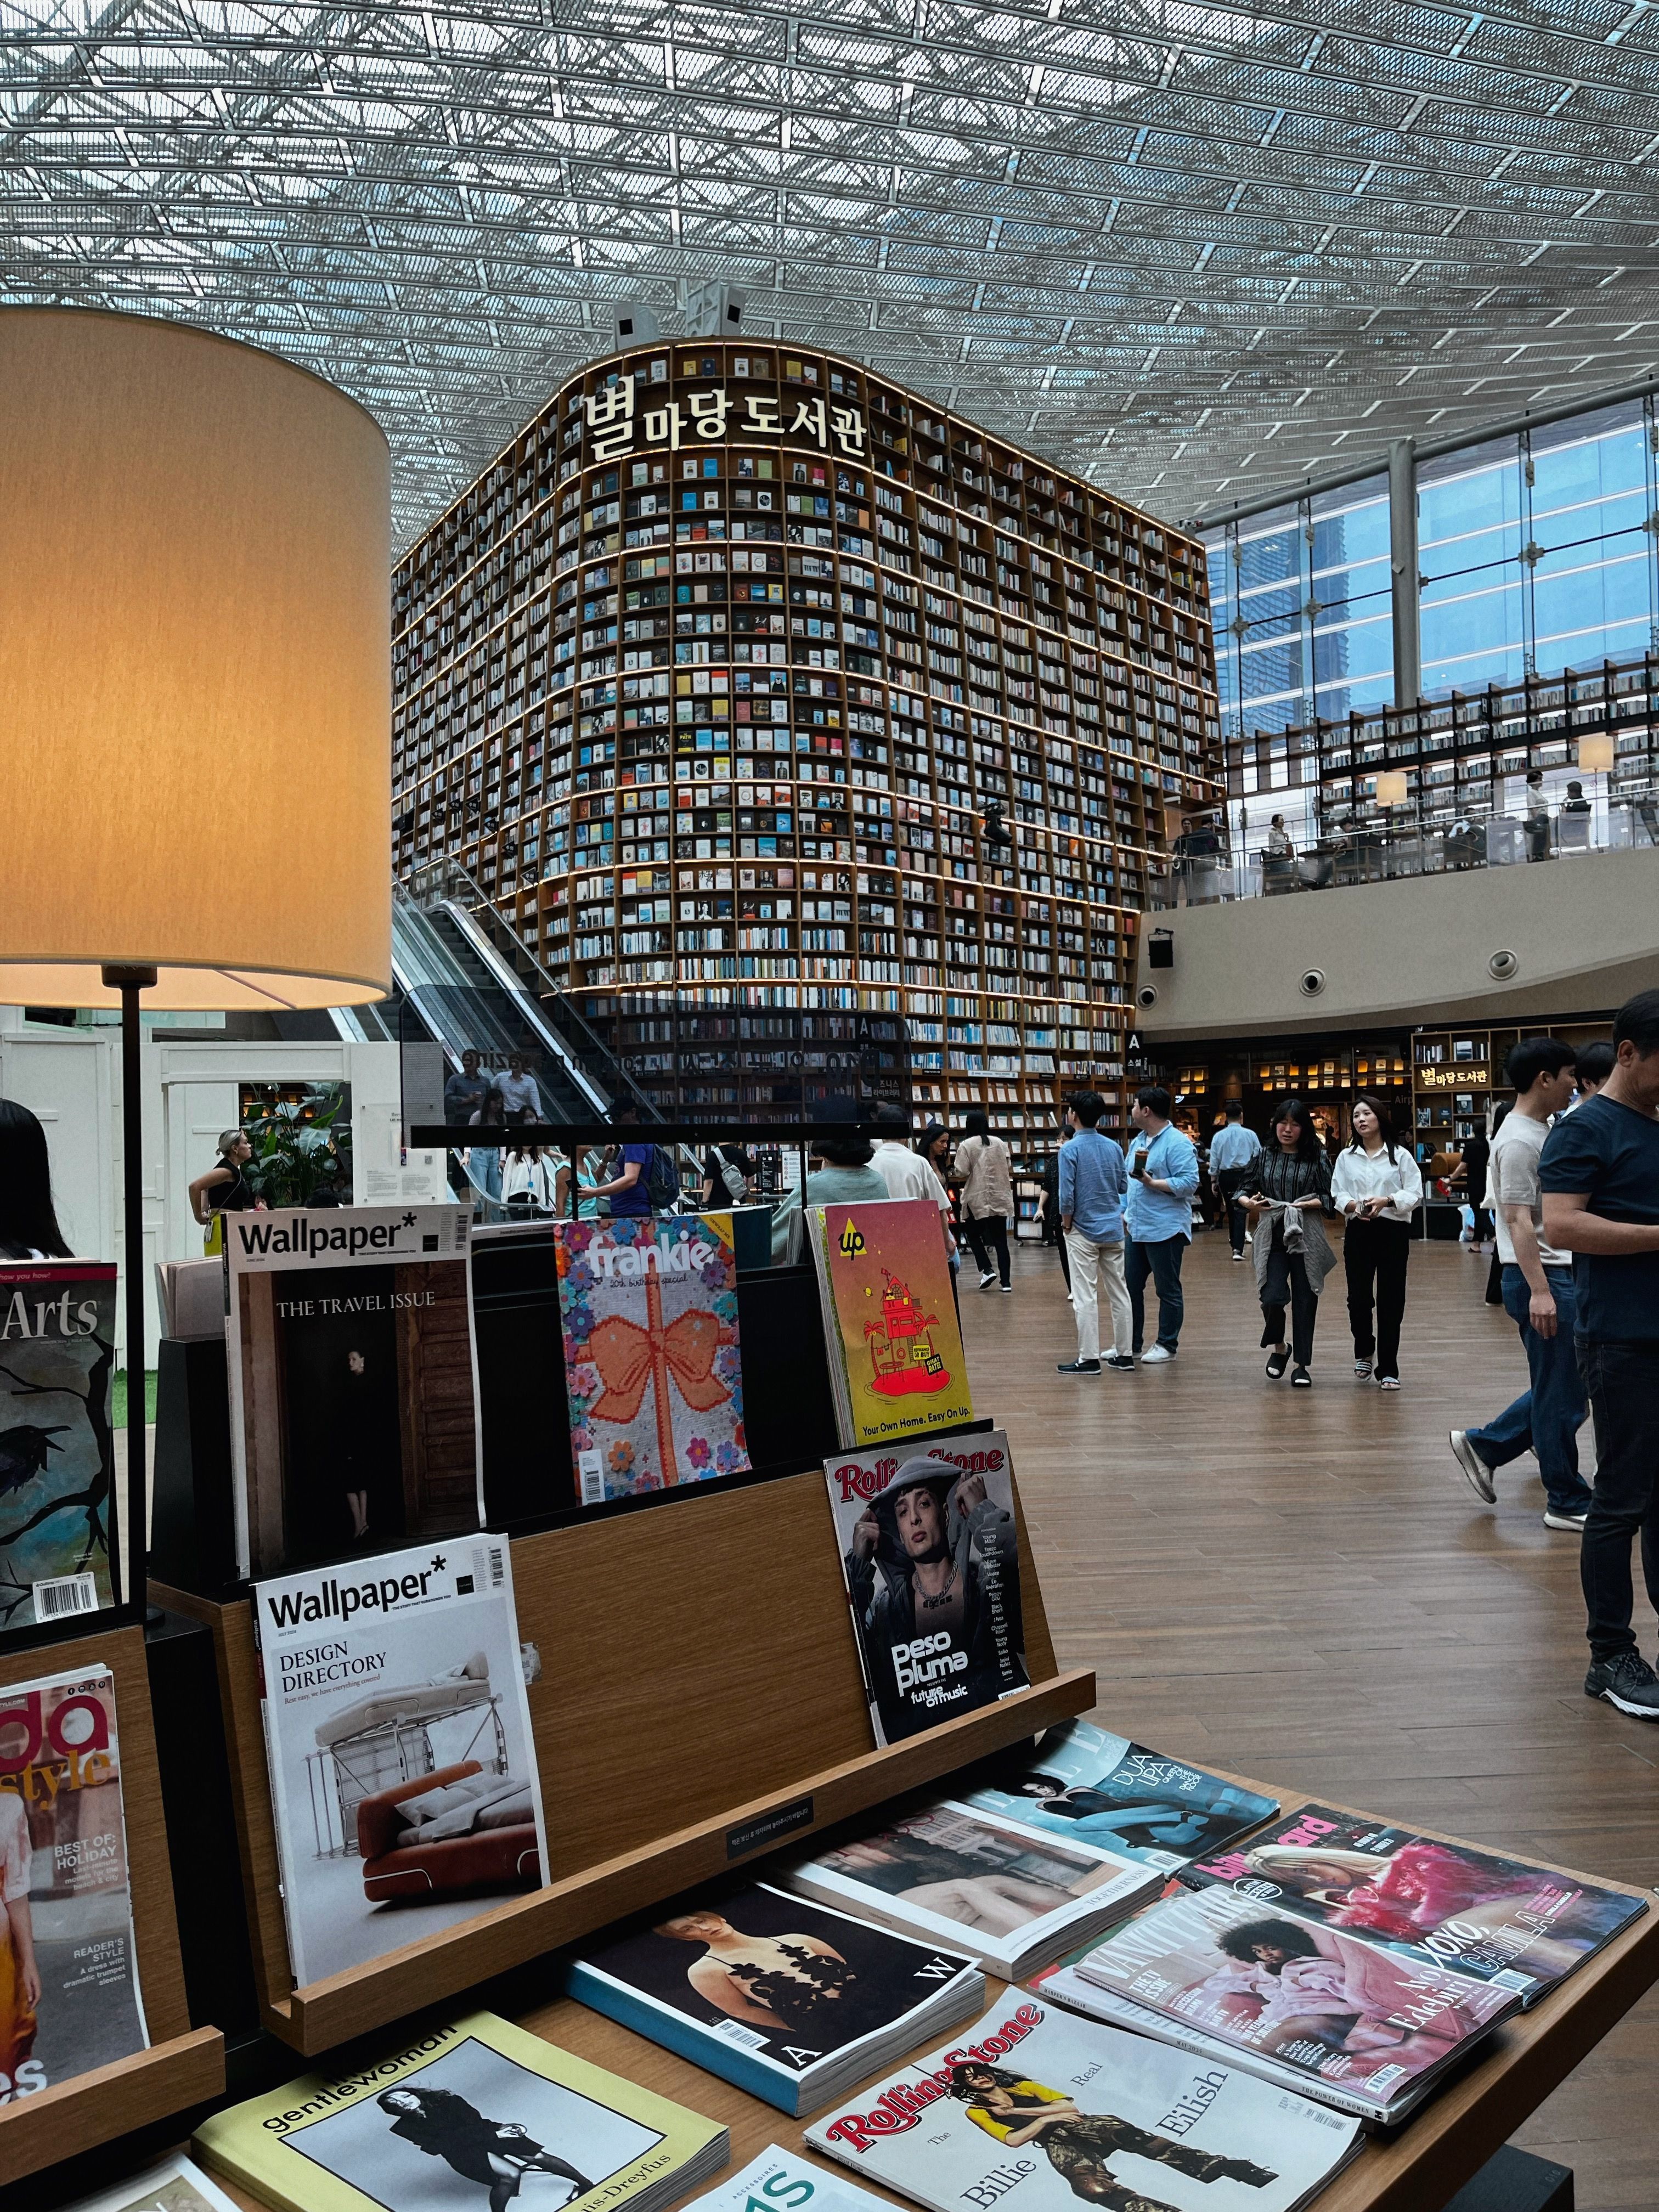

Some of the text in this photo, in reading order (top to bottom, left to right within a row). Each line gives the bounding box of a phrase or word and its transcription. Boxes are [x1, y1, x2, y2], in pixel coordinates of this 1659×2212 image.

[860, 1018, 868, 1035] A
[1128, 1034, 1140, 1049] A
[585, 1230, 714, 1278] frankie
[838, 1232, 865, 1261] up
[0, 1290, 98, 1340] Arts
[276, 1291, 436, 1318] THE TRAVEL ISSUE
[862, 1407, 970, 1436] Your Own Home. Easy On Up.
[834, 1457, 904, 1503] Rolli
[280, 1640, 348, 1672] DESIGN
[282, 1652, 387, 1693] DIRECTORY
[284, 1696, 297, 1705] Rest
[332, 1680, 361, 1692] everything
[360, 1674, 380, 1684] covered
[911, 1685, 944, 1704] future
[938, 1684, 968, 1702] music
[0, 1749, 111, 1810] style
[1112, 1756, 1153, 1786] DUA
[1137, 1763, 1172, 1787] LIPA
[1162, 1764, 1178, 1784] QUEEN
[1178, 1773, 1197, 1790] DANCE
[1179, 1770, 1191, 1780] THE
[55, 1833, 116, 1858] BEST OF:
[57, 1844, 116, 1870] HOLIDAY
[1194, 1814, 1339, 1881] billard
[1084, 1868, 1149, 1905] TOGETHERNESS
[1239, 1880, 1262, 1894] LATIN
[74, 1937, 123, 1959] READER'S
[1080, 1913, 1201, 1980] VANITY
[1409, 1920, 1489, 1969] XOXO,
[1459, 1910, 1556, 1972] CAMILA
[87, 1962, 108, 1972] dress
[109, 1957, 125, 1966] with
[93, 1946, 125, 1962] STYLE
[63, 1965, 126, 1989] dramatic trumpet
[99, 1973, 126, 1986] sleeves
[913, 1956, 957, 1979] W
[1128, 1976, 1152, 1993] THE
[1142, 1969, 1161, 1980] TV
[1142, 1977, 1172, 2000] ISSUE
[1393, 1971, 1442, 1996] Ayo
[1043, 1988, 1086, 2008] HARPER'S BAZAAR
[1173, 1987, 1204, 2012] SUCCESSION
[1183, 1999, 1204, 2016] DRAMA
[1385, 1978, 1475, 2032] Edebiri
[943, 2002, 1046, 2068] Stone
[1177, 2040, 1187, 2048] MAY
[1250, 2036, 1262, 2045] OF
[781, 2045, 822, 2067] A
[1317, 2061, 1327, 2070] The
[262, 2025, 458, 2133] gentlewoman
[927, 2061, 1104, 2146] The Real
[1301, 2086, 1314, 2095] THE
[1314, 2090, 1336, 2103] POWER
[1346, 2102, 1370, 2114] WOMEN
[960, 2070, 1229, 2210] Billie Eilish
[732, 2163, 778, 2200] ACCESSOIRES
